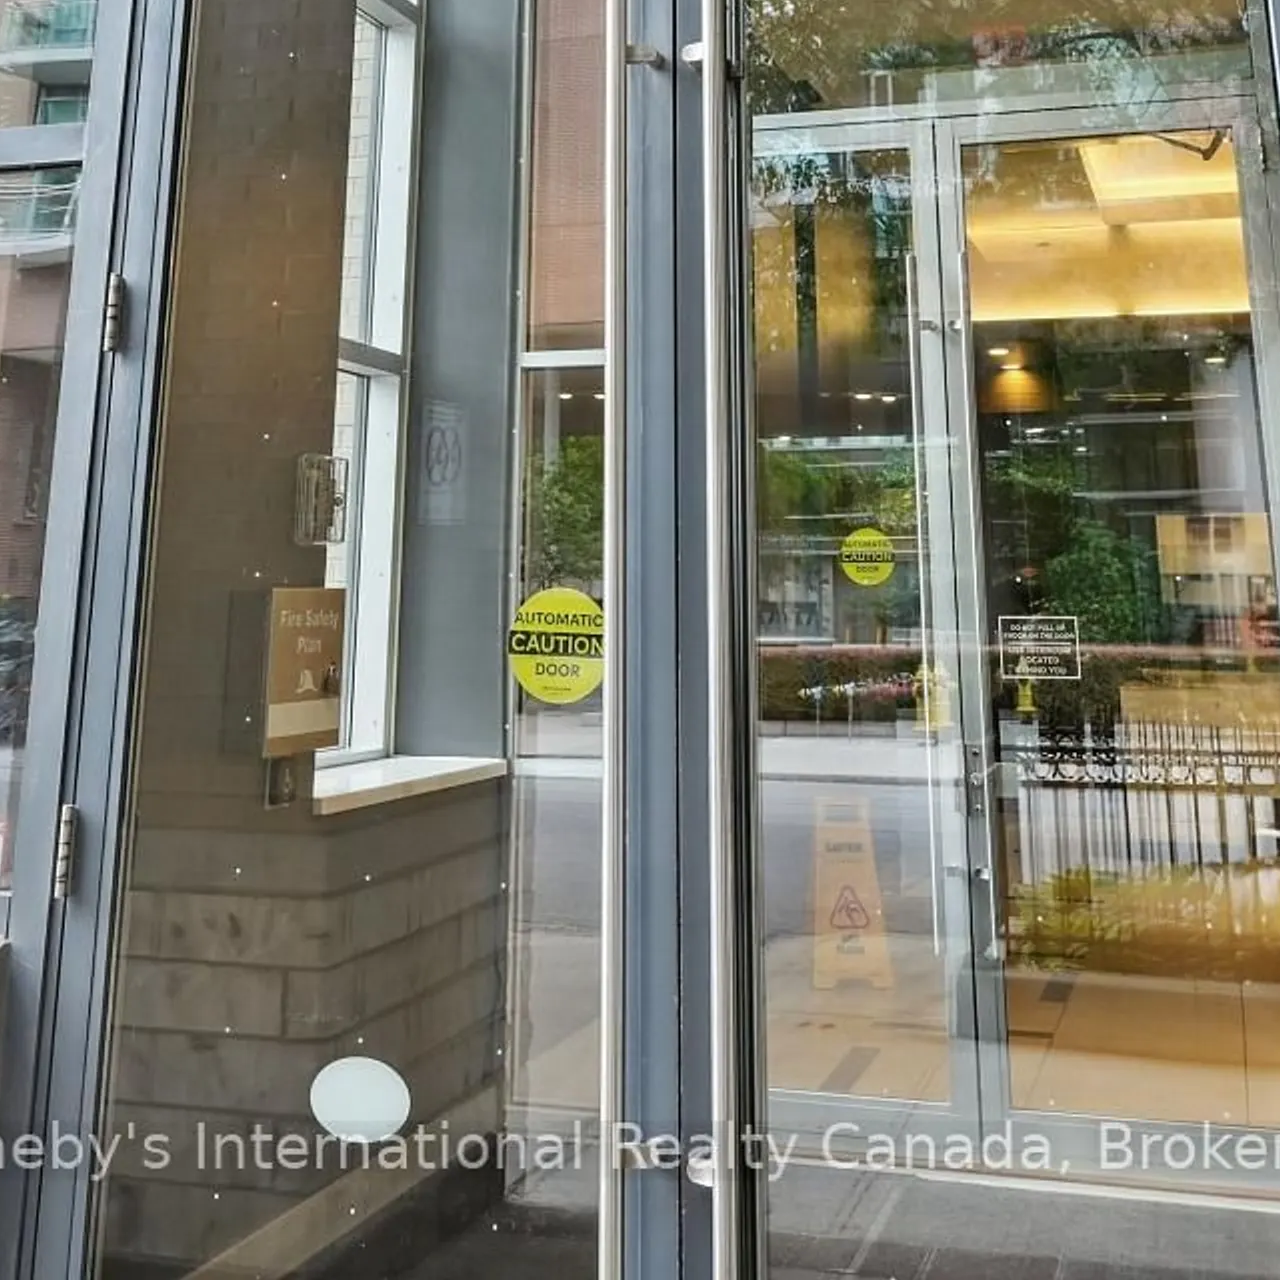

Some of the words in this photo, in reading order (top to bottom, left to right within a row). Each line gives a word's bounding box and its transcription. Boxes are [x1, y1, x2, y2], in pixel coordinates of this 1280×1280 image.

[514, 611, 603, 627] AUTOMATIC
[511, 633, 604, 656] CAUTION
[1020, 656, 1060, 665] OCATED
[535, 662, 580, 677] DOOR
[1015, 666, 1047, 674] HIND
